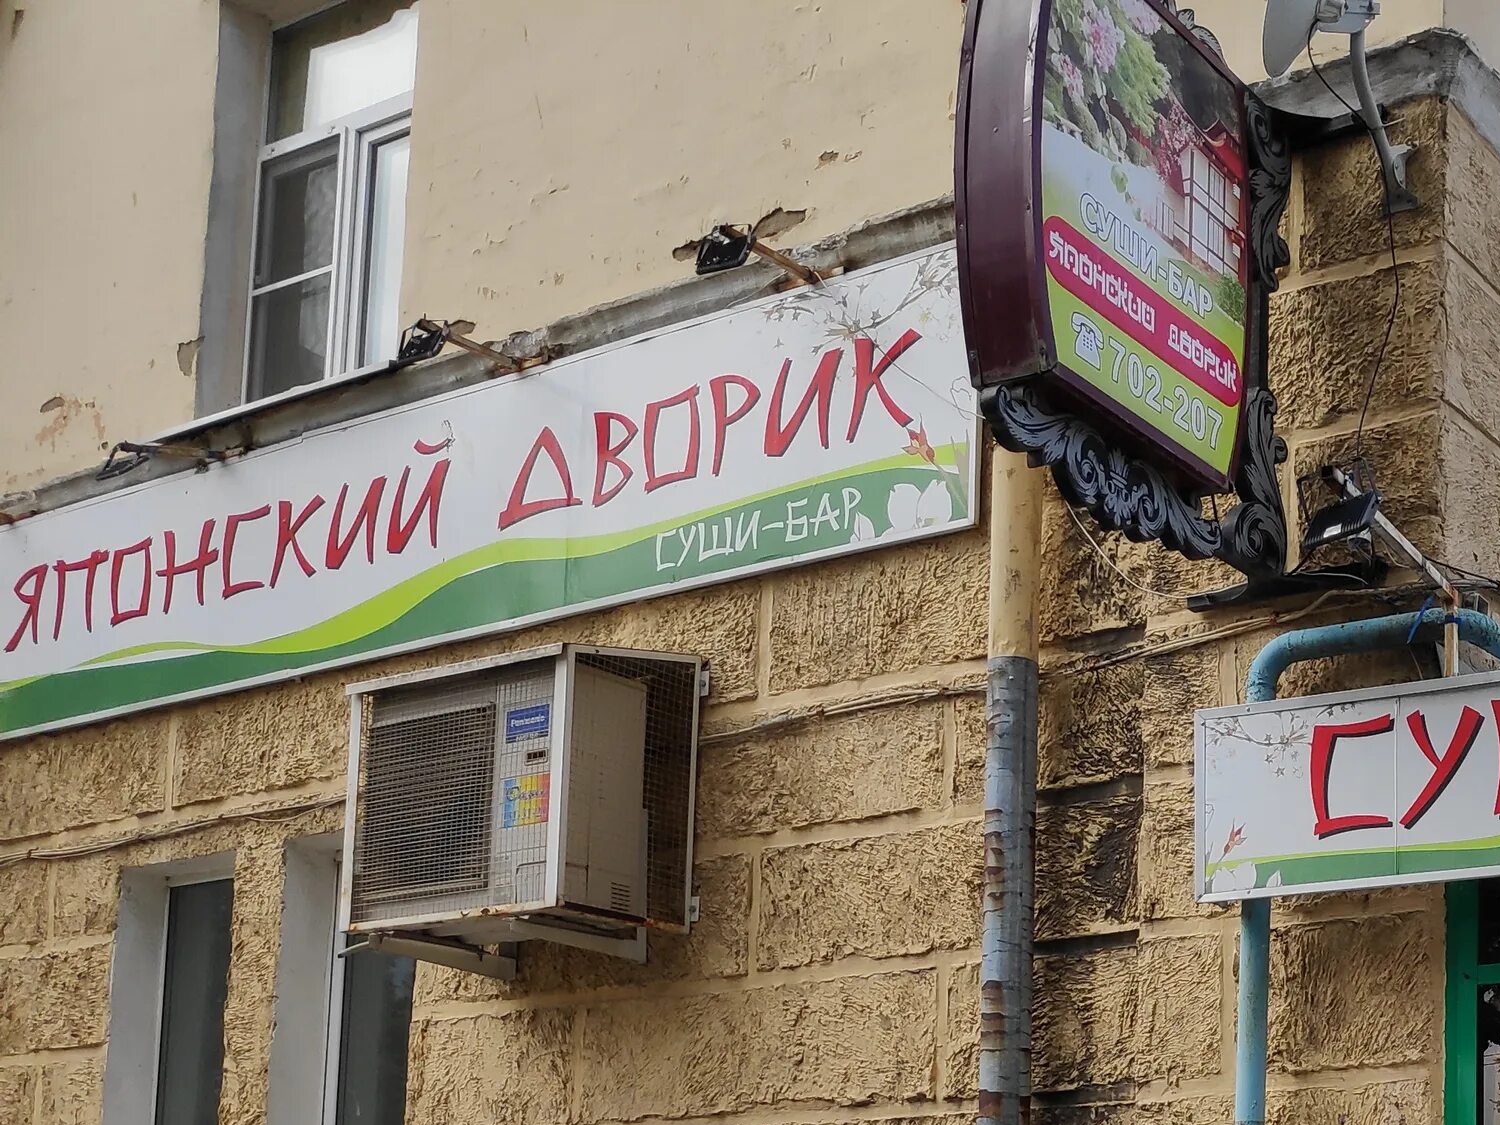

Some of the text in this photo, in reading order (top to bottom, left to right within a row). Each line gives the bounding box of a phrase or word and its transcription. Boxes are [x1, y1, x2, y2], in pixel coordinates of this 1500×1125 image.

[1049, 231, 1237, 392] ЯПОНСКИЙ ДВОРИК
[1080, 193, 1214, 319] СУШИ-БАР
[1109, 336, 1223, 450] 702-207
[3, 328, 922, 653] ЯПОНСКИЙ ДВОРИК
